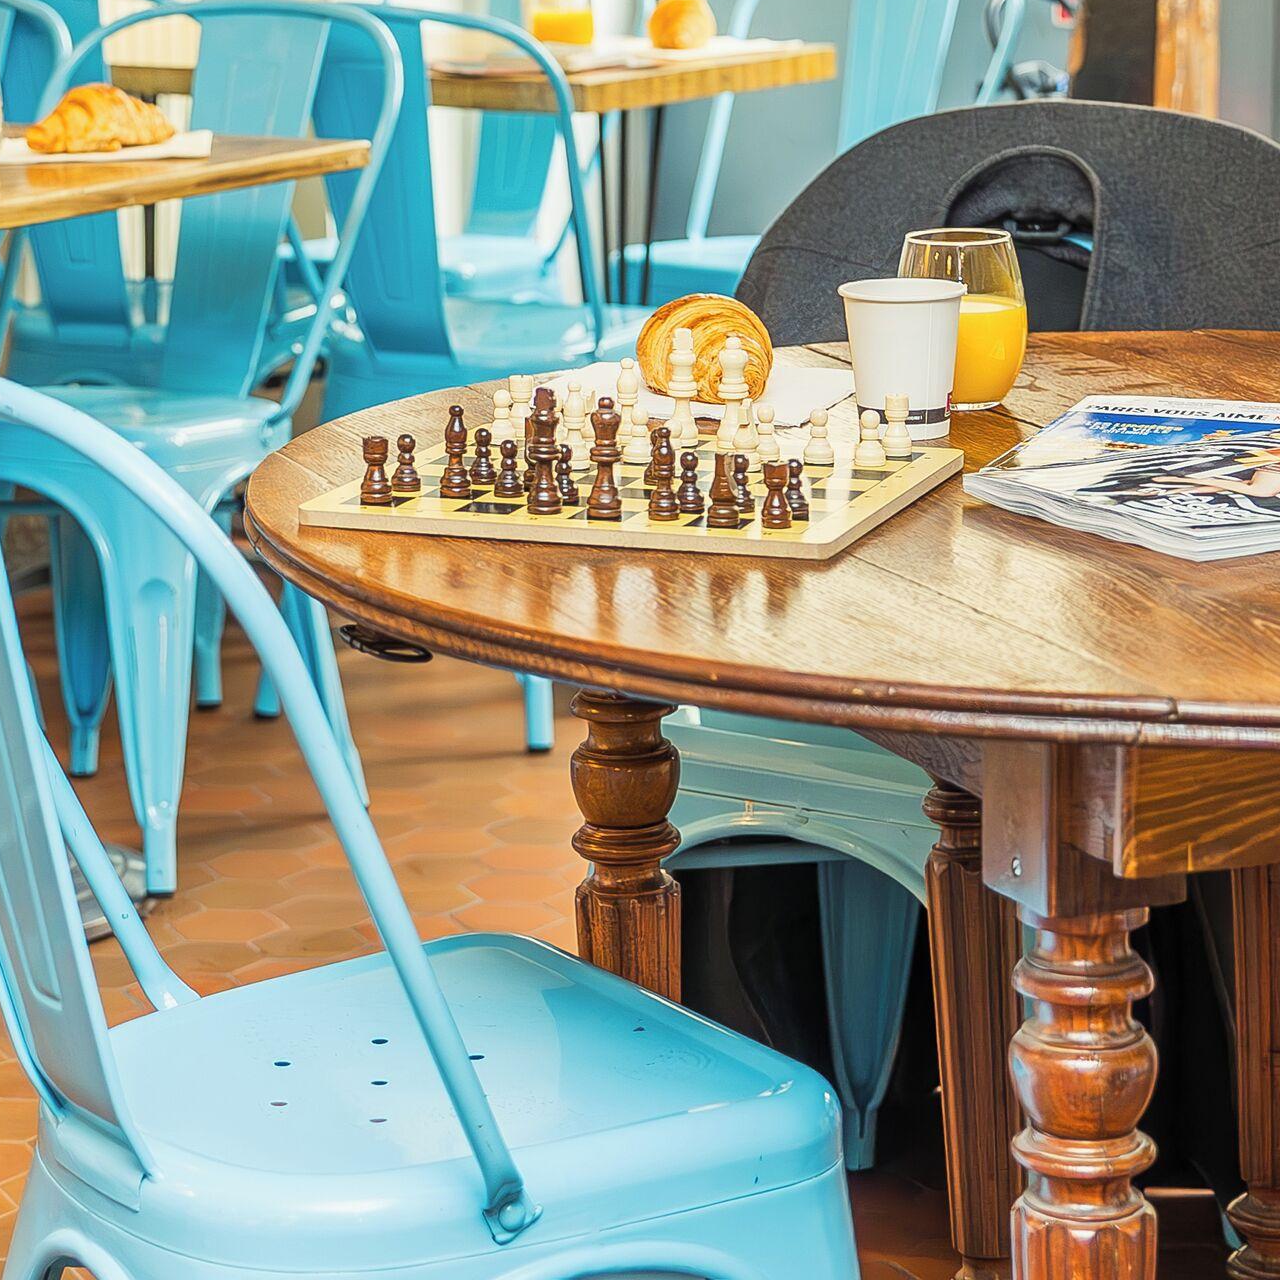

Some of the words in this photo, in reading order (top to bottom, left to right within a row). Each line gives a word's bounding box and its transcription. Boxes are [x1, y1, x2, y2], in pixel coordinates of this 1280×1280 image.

[1085, 404, 1148, 413] PARIS
[1153, 408, 1210, 417] VOUS
[1214, 412, 1268, 421] AIME
